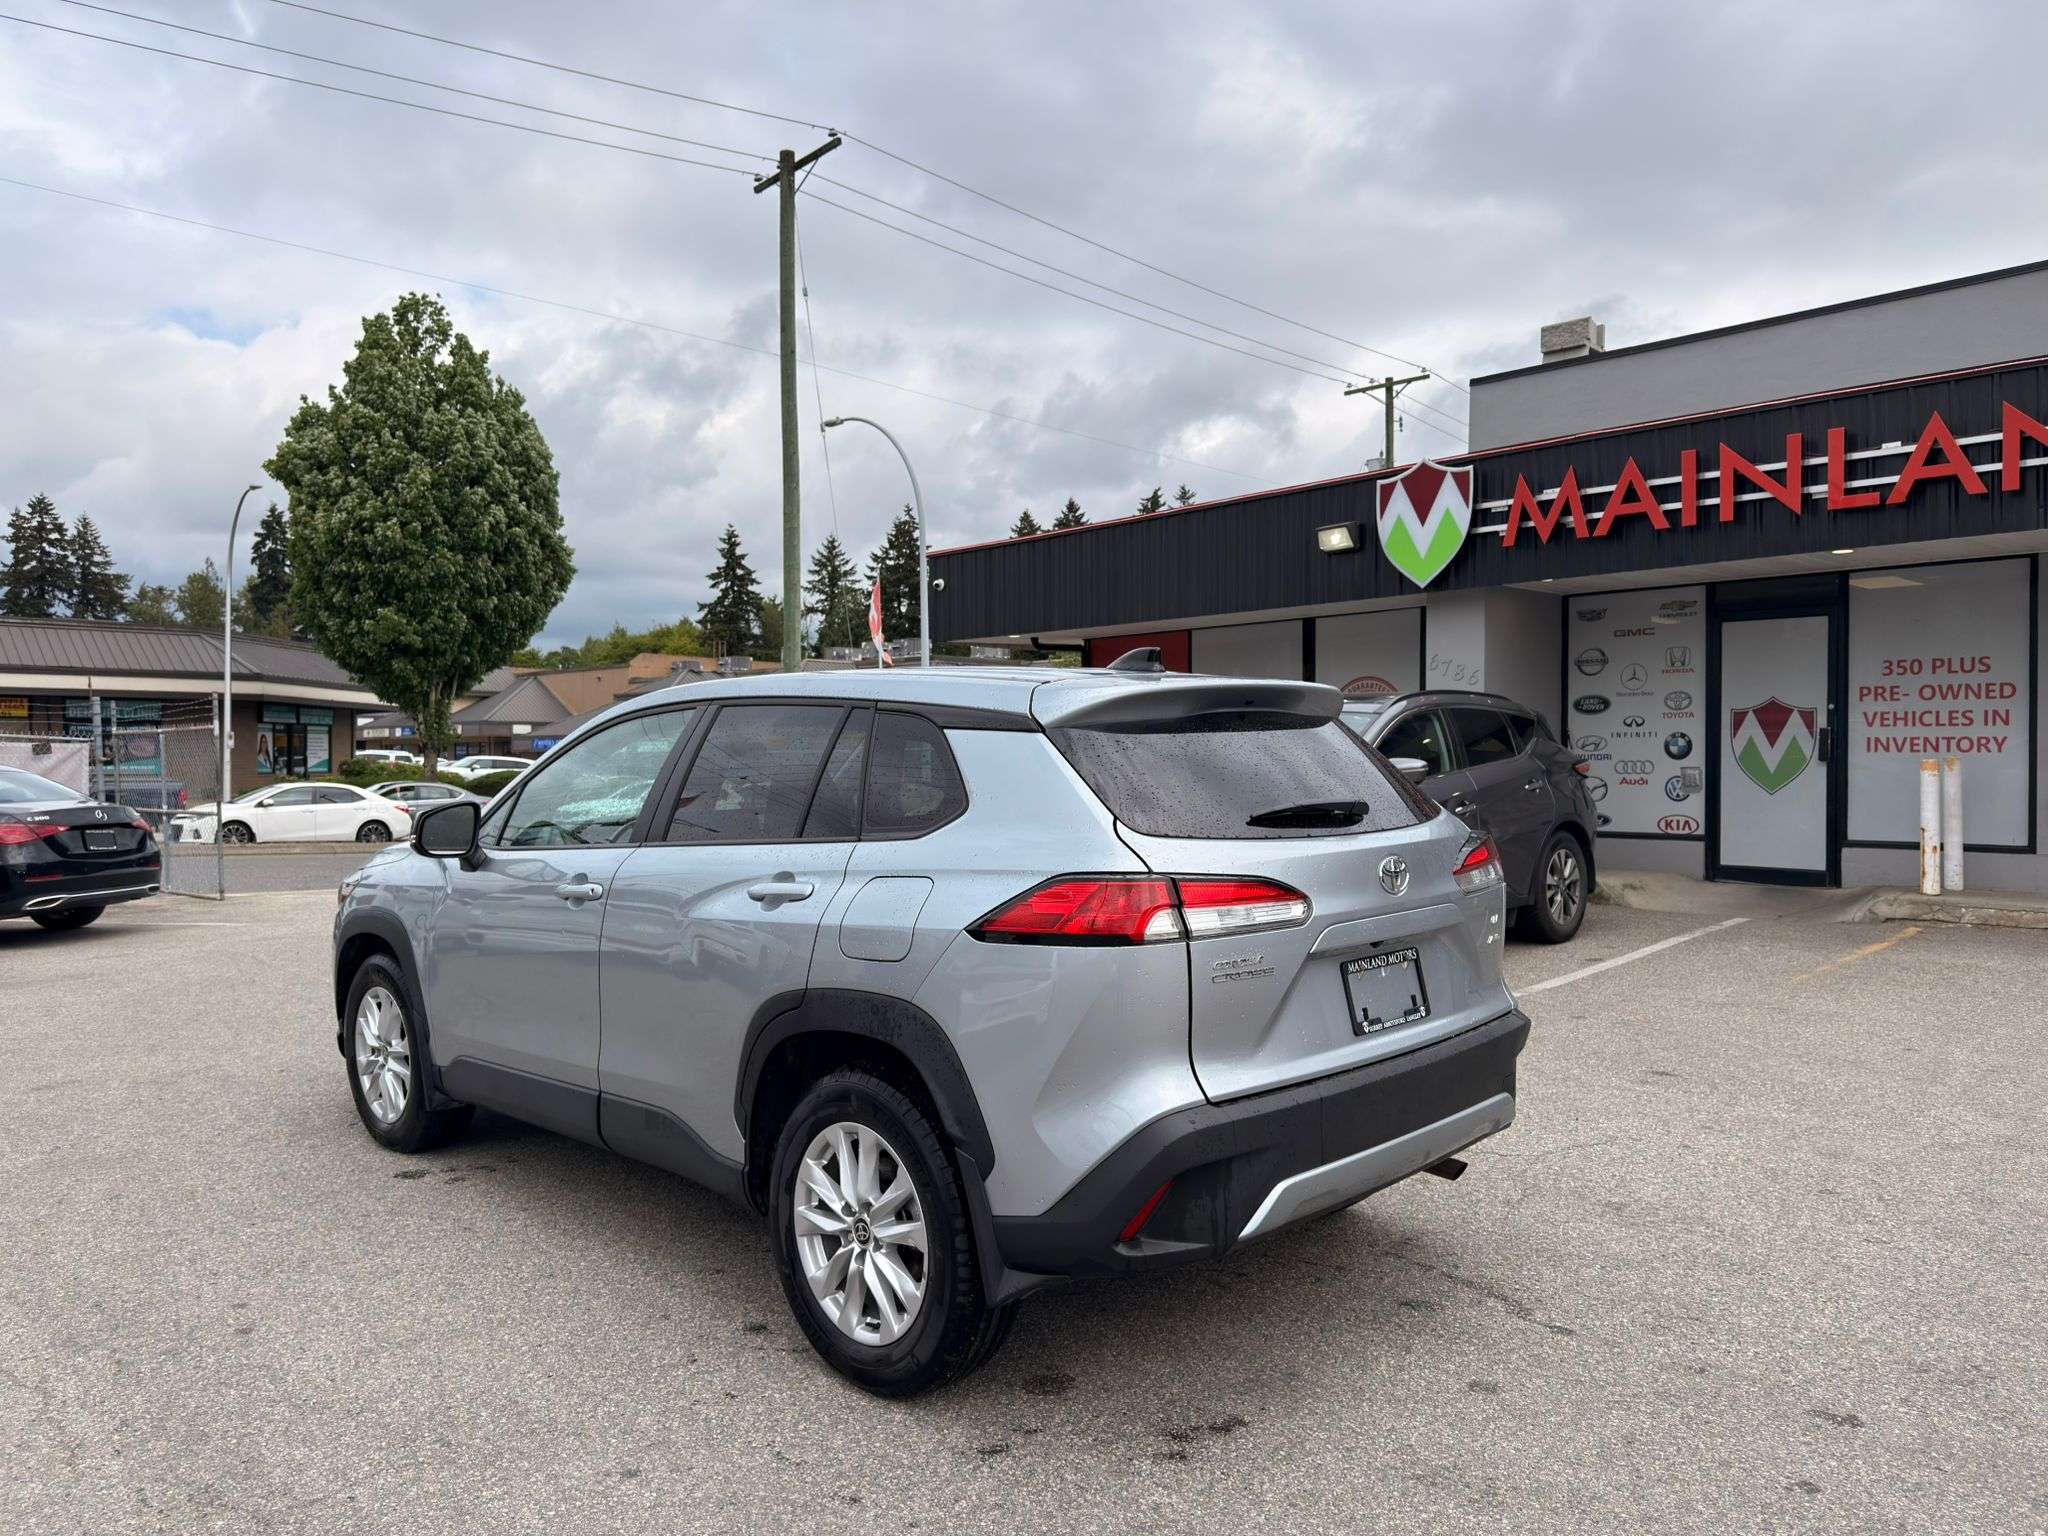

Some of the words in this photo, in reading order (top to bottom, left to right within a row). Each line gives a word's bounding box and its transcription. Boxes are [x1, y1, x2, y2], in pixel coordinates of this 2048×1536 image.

[1613, 627, 1656, 638] GMC
[1662, 667, 1695, 675] HONDA
[1882, 658, 1923, 677] 350
[1931, 656, 1992, 674] PLUS
[1858, 685, 1910, 702] PRE-
[1918, 682, 2017, 701] OWNED
[1662, 711, 1695, 719] TOYOTA
[1862, 709, 1975, 728] VEHICLES
[1983, 708, 2010, 727] IN
[1610, 731, 1658, 739] INFINITI
[1865, 736, 2008, 753] INVENTORY
[1619, 777, 1649, 786] Audi
[1664, 819, 1693, 832] KIA
[1347, 955, 1388, 974] MAINLAND
[1388, 948, 1417, 965] MOTORS
